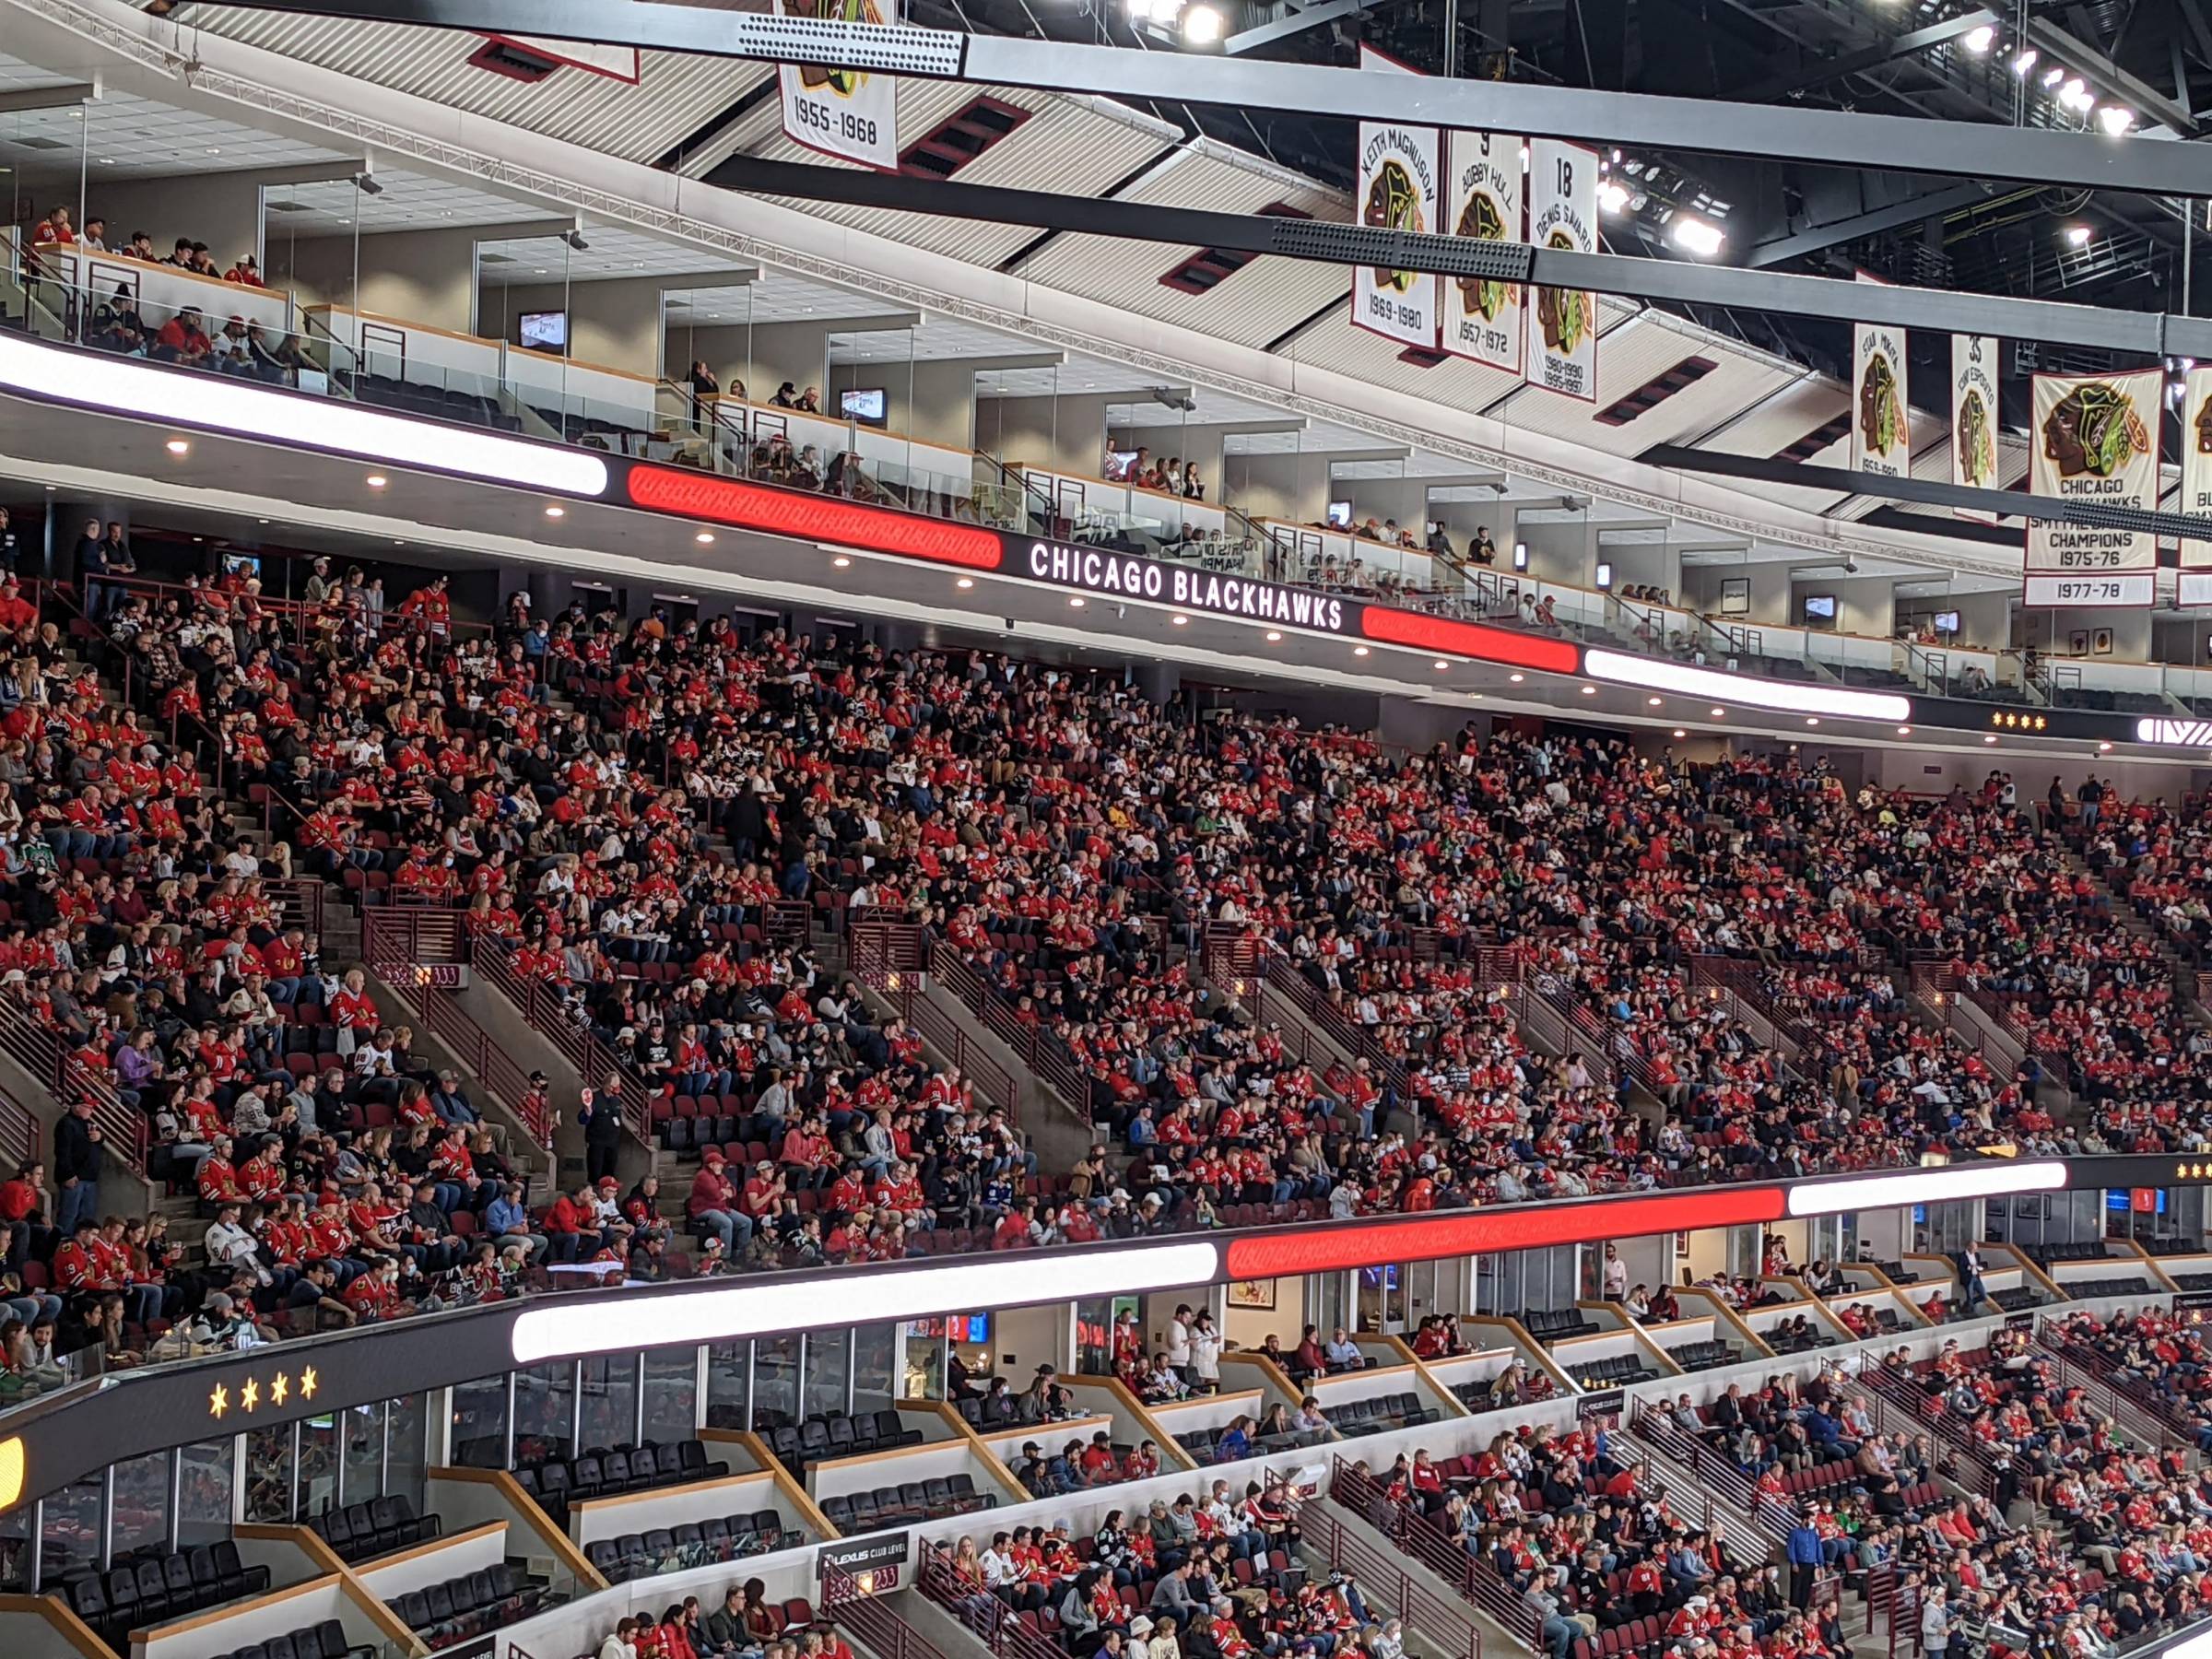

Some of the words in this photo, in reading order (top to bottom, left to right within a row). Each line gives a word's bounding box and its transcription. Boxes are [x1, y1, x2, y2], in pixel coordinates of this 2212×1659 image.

[794, 96, 877, 146] 1955-1968
[1360, 129, 1387, 179] KEITH
[1387, 128, 1435, 203] MAGNUSON
[1557, 157, 1572, 198] 18
[1462, 162, 1489, 195] BOBBY
[1490, 168, 1512, 212] HULL
[1369, 293, 1422, 331] 1969-1980
[1459, 320, 1508, 353] 1957-1972
[1969, 335, 1982, 363] 35
[2060, 478, 2124, 494] CHICAGO
[2049, 533, 2133, 548] CHAMPIONS
[2060, 551, 2121, 566] 1975-76
[1030, 543, 1162, 596] CHICAGO
[1173, 570, 1342, 630] BLACKHAWKS
[2057, 583, 2121, 598] 1977-78
[833, 1550, 869, 1565] LEXUS
[869, 1546, 887, 1559] CLUB
[888, 1543, 906, 1556] LEVEL
[875, 1567, 896, 1588] 233
